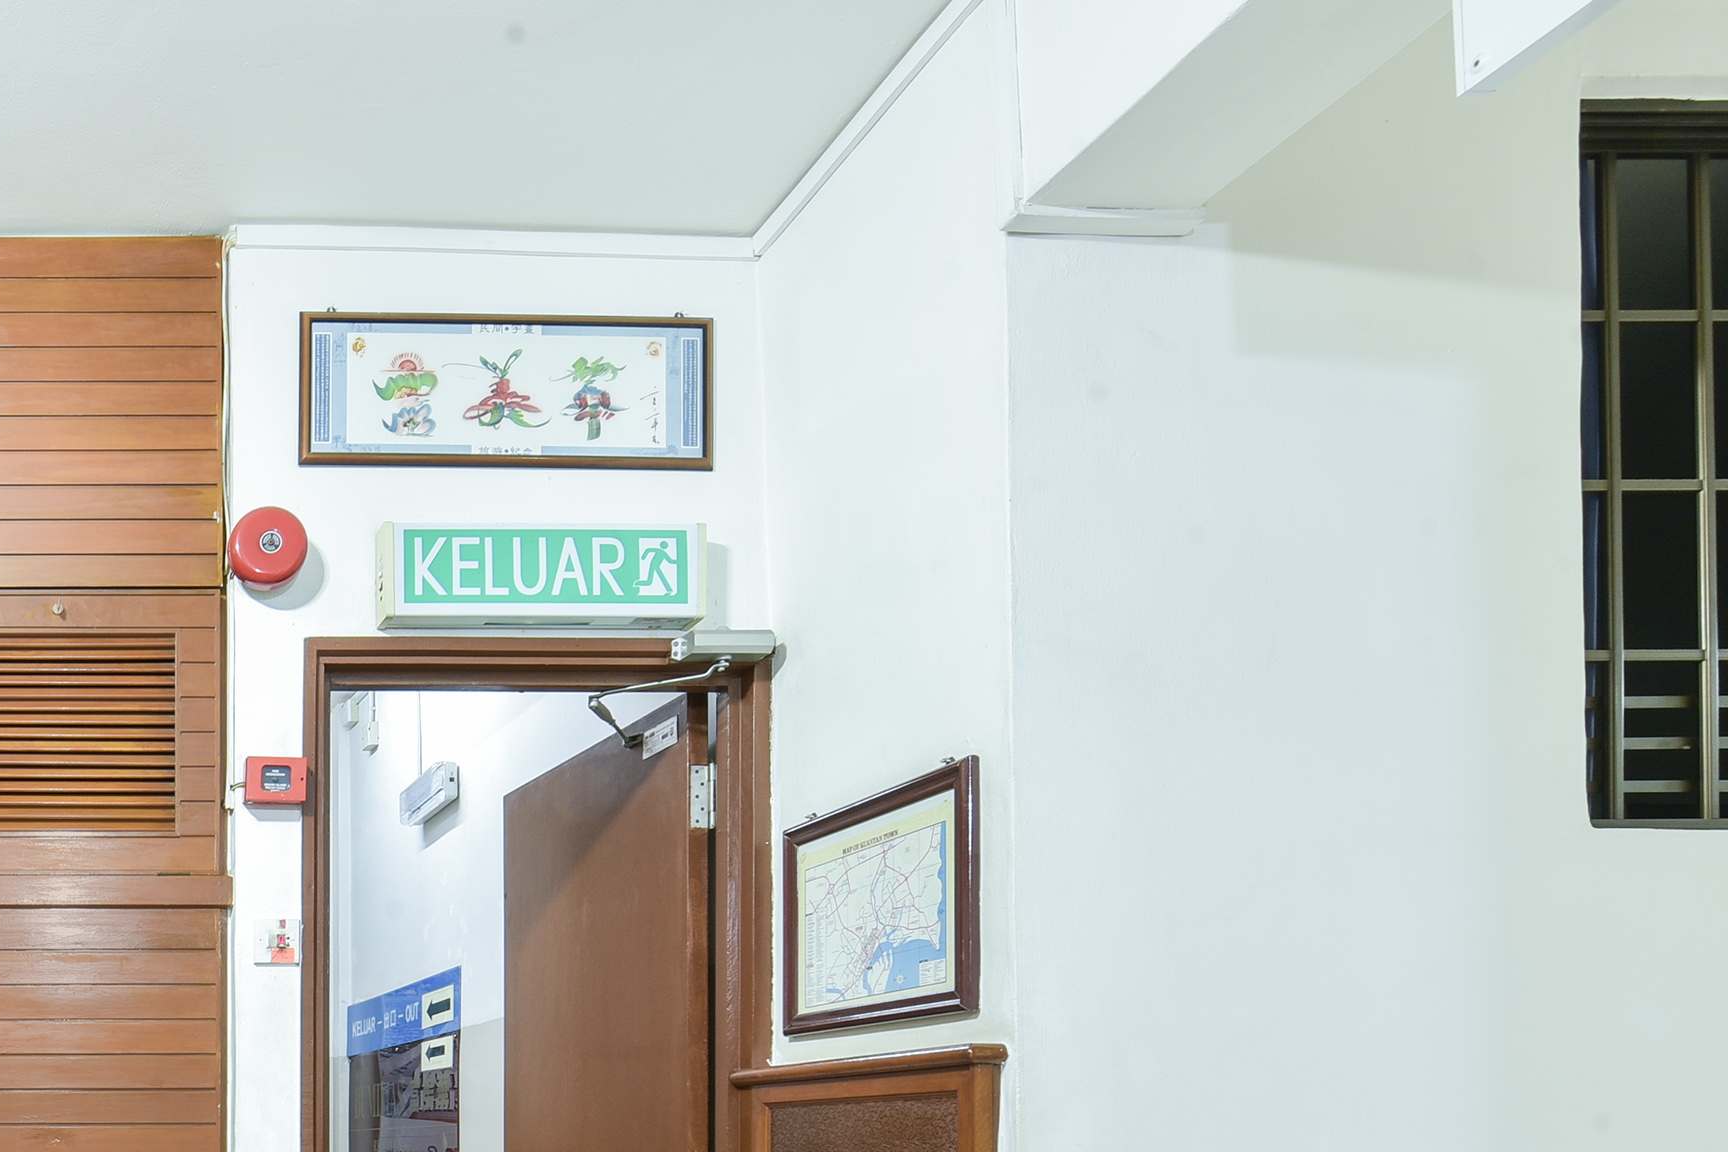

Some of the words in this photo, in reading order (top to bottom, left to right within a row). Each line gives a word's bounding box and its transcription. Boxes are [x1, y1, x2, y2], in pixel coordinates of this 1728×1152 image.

[414, 536, 625, 596] KELUAR
[352, 1016, 376, 1037] KELUAR
[383, 1009, 397, 1030] 出口
[405, 1002, 420, 1023] OUT
